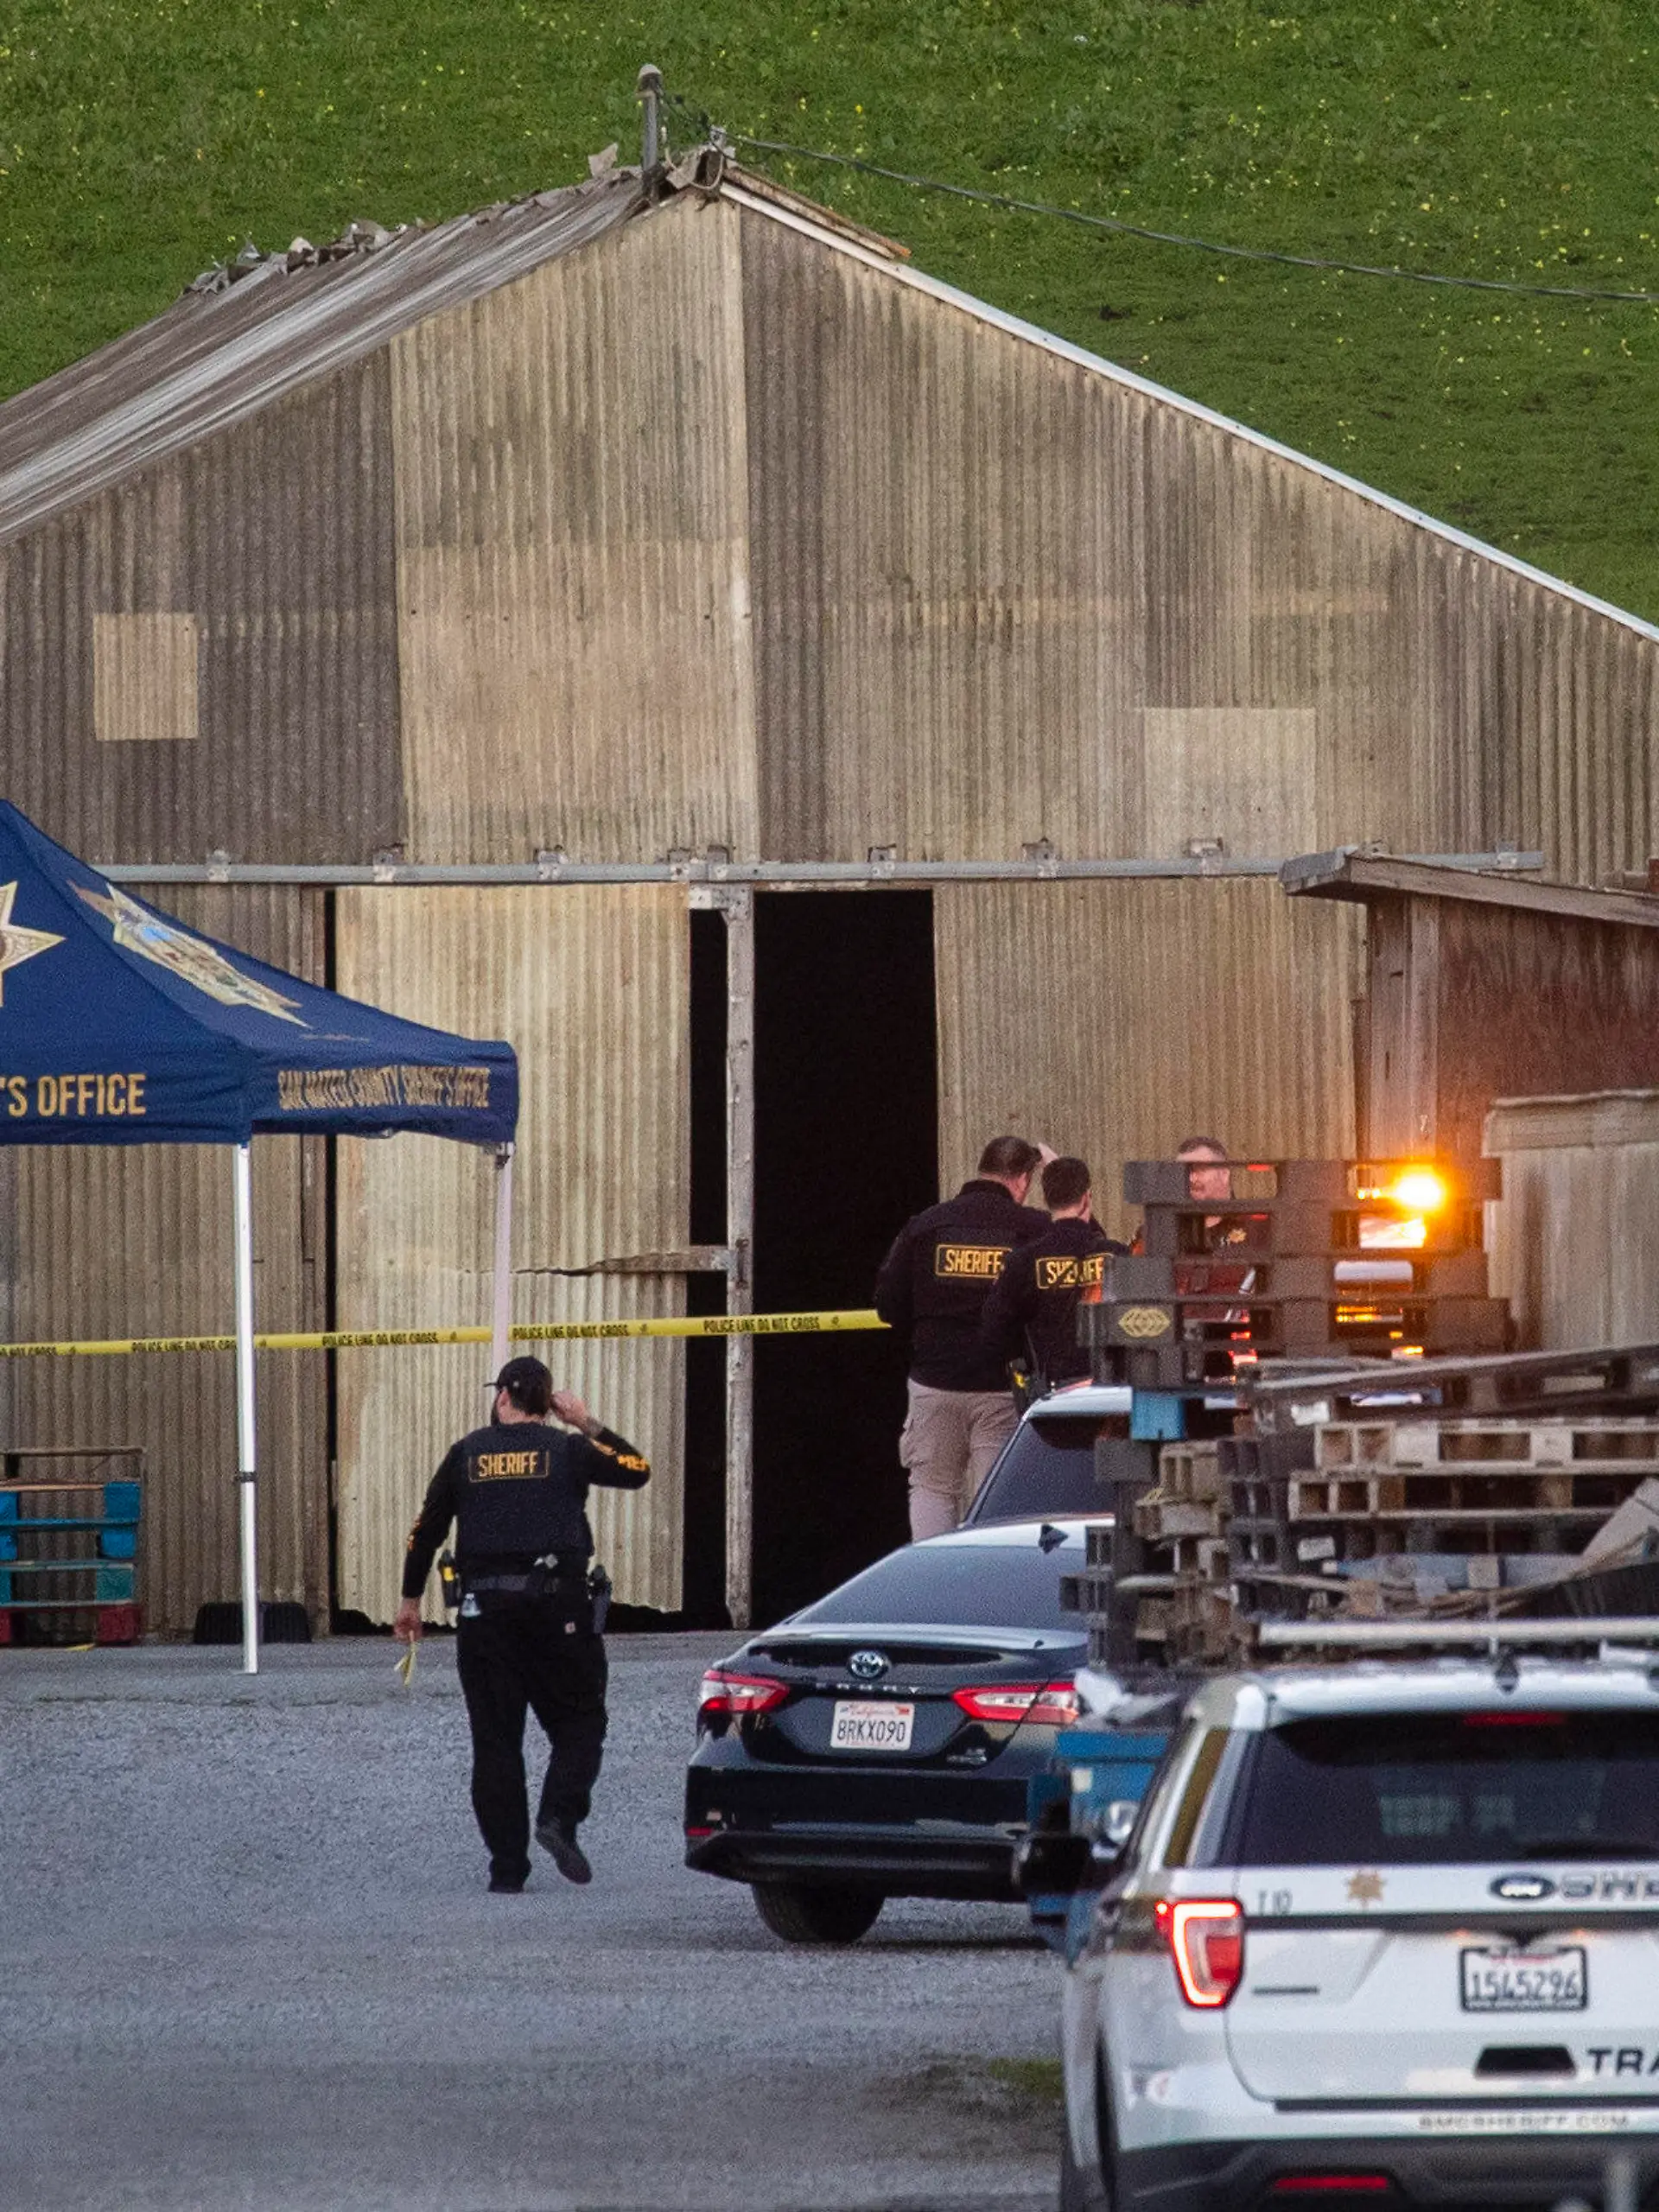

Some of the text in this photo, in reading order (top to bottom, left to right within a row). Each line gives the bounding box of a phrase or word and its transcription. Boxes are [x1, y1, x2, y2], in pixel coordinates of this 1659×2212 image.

[37, 1073, 146, 1116] OFFICE
[944, 1249, 1004, 1274] SHERIFF
[512, 1326, 543, 1339] POLICE
[545, 1325, 564, 1338] LINE
[580, 1325, 596, 1338] NOT
[600, 1324, 630, 1338] CROSS
[703, 1316, 820, 1333] POLICE LINE DO NOT CROSS
[322, 1334, 353, 1346] POLICE
[409, 1332, 439, 1344] CROSS
[478, 1451, 538, 1478] SHERIFF
[836, 1719, 906, 1743] 8RKX090
